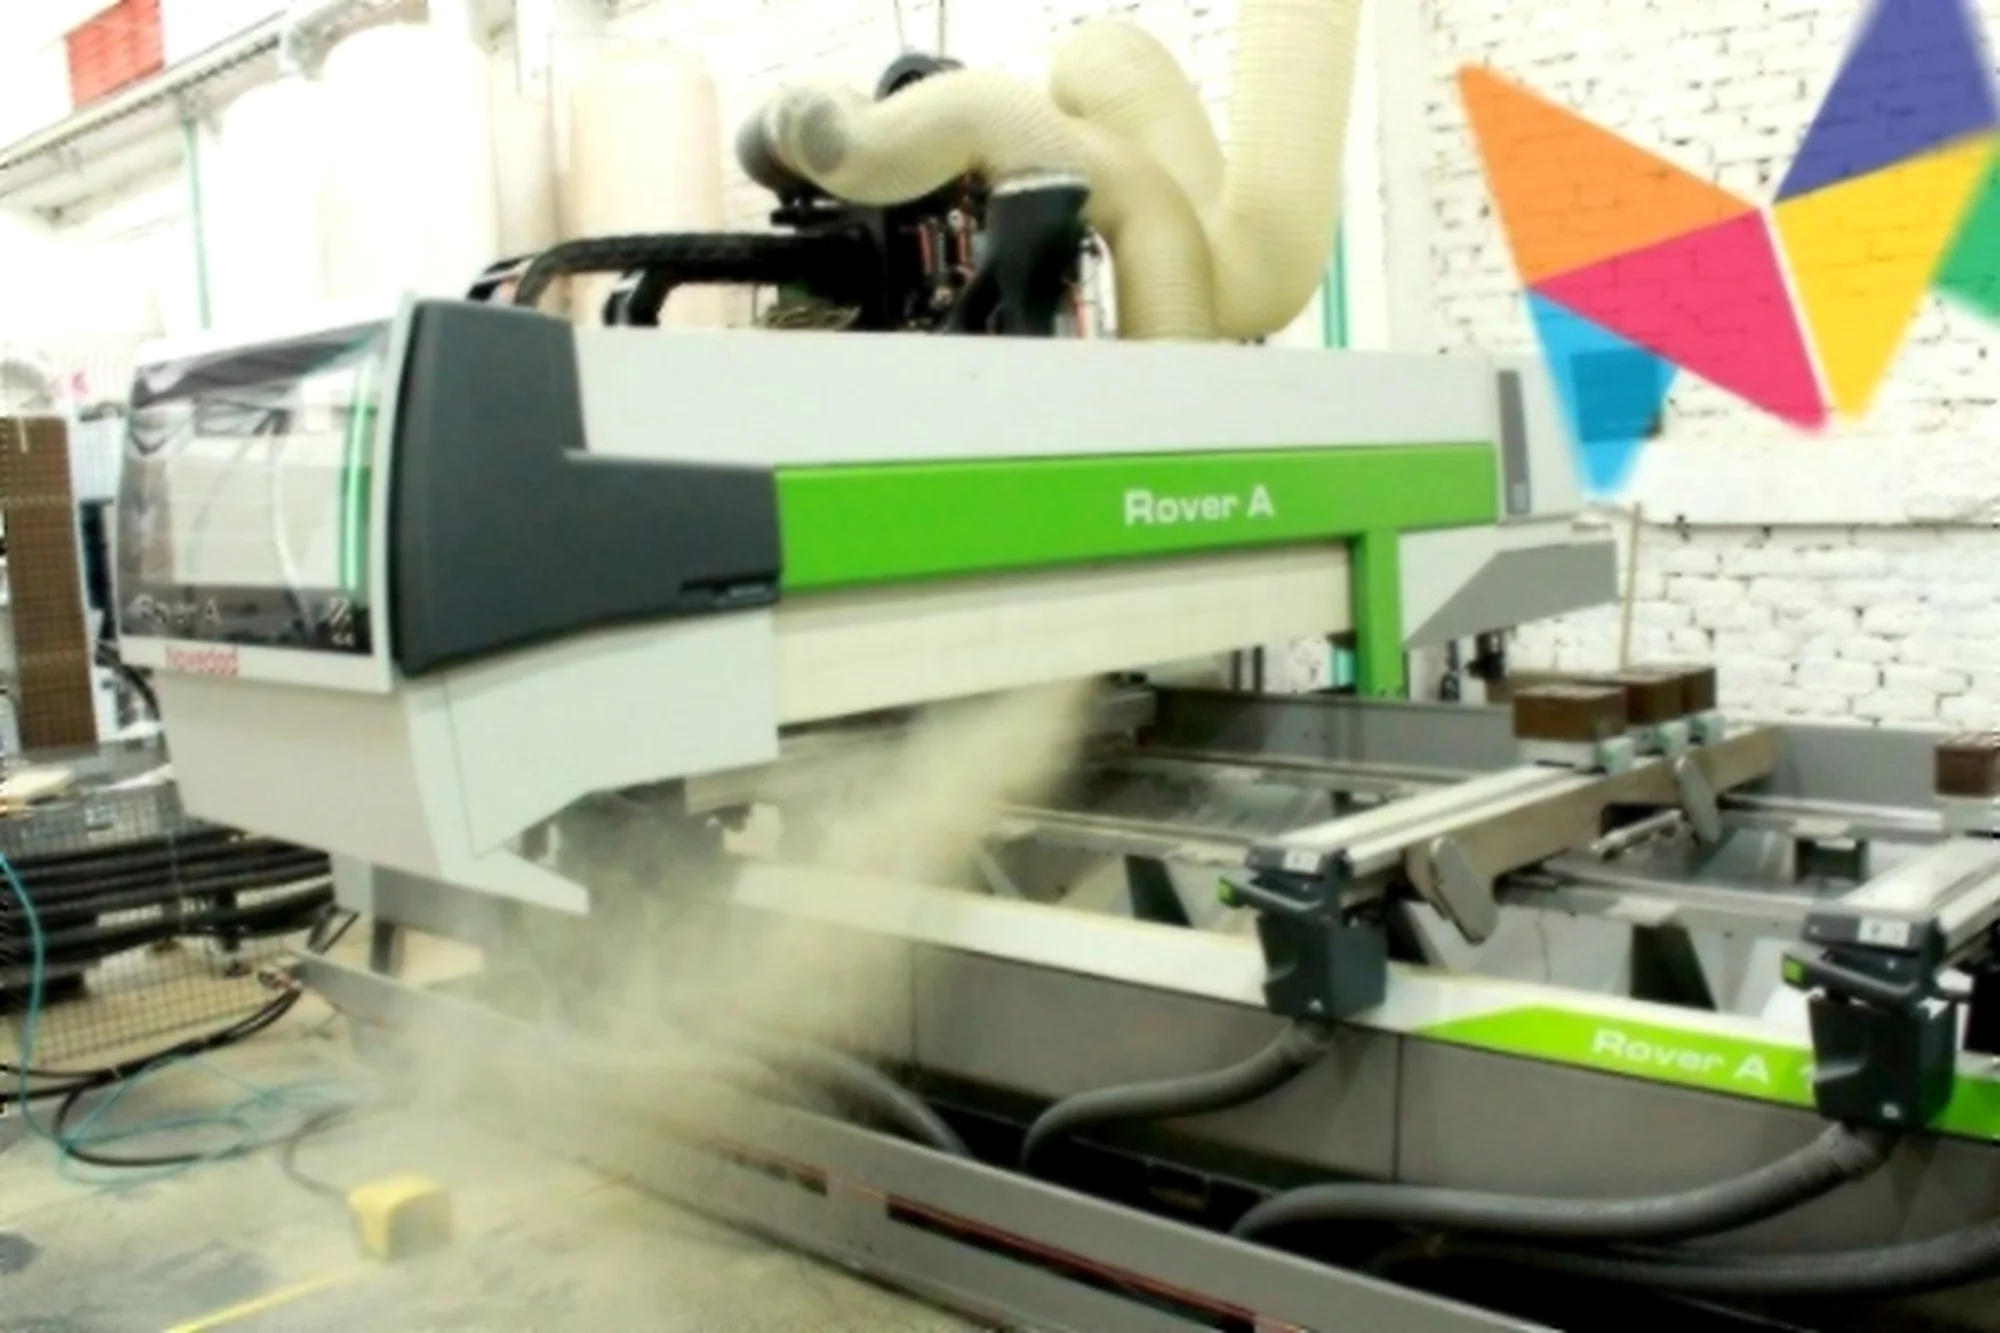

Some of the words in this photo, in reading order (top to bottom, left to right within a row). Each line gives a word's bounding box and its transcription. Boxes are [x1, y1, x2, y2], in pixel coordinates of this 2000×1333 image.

[1125, 489, 1238, 526] Rover
[1247, 483, 1276, 518] A
[1593, 1028, 1723, 1072] Rover
[1734, 1054, 1769, 1082] A
